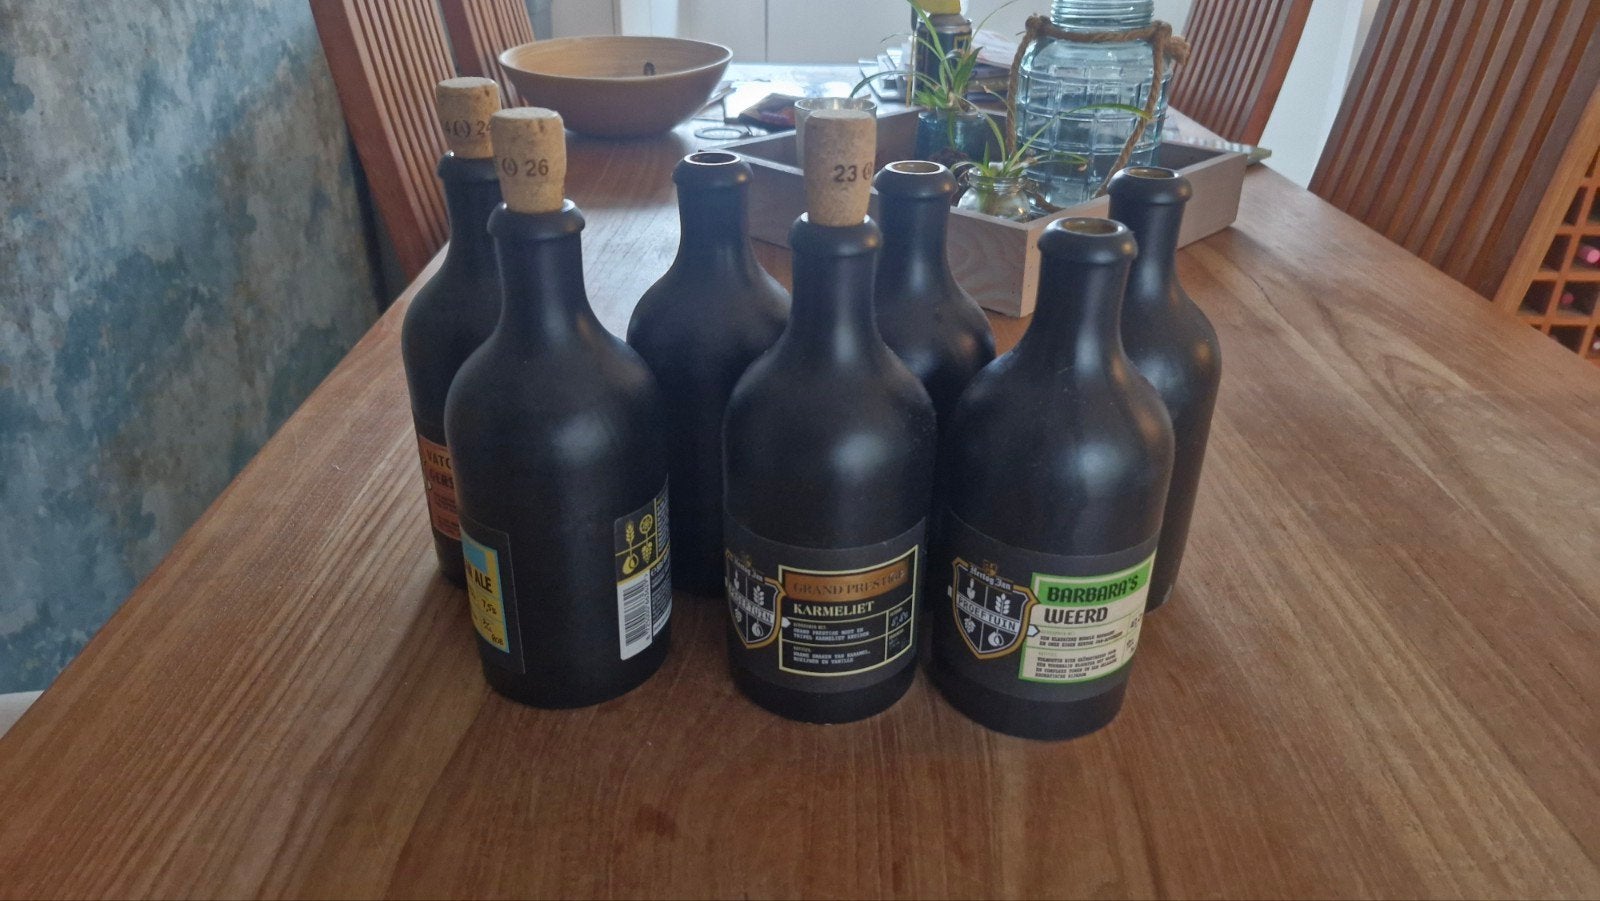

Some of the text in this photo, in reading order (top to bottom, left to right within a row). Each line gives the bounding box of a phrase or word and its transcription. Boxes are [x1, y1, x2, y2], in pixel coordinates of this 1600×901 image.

[525, 159, 549, 177] 26
[834, 164, 857, 182] 23
[475, 568, 493, 593] ALE
[793, 569, 905, 595] GRAND PRESTIGE
[970, 565, 1011, 590] Hertog Jan
[1047, 574, 1139, 603] BARBARA'S
[793, 601, 875, 617] KARMELIET
[959, 598, 1016, 631] PROEFTUIN
[1044, 606, 1109, 625] WEERD
